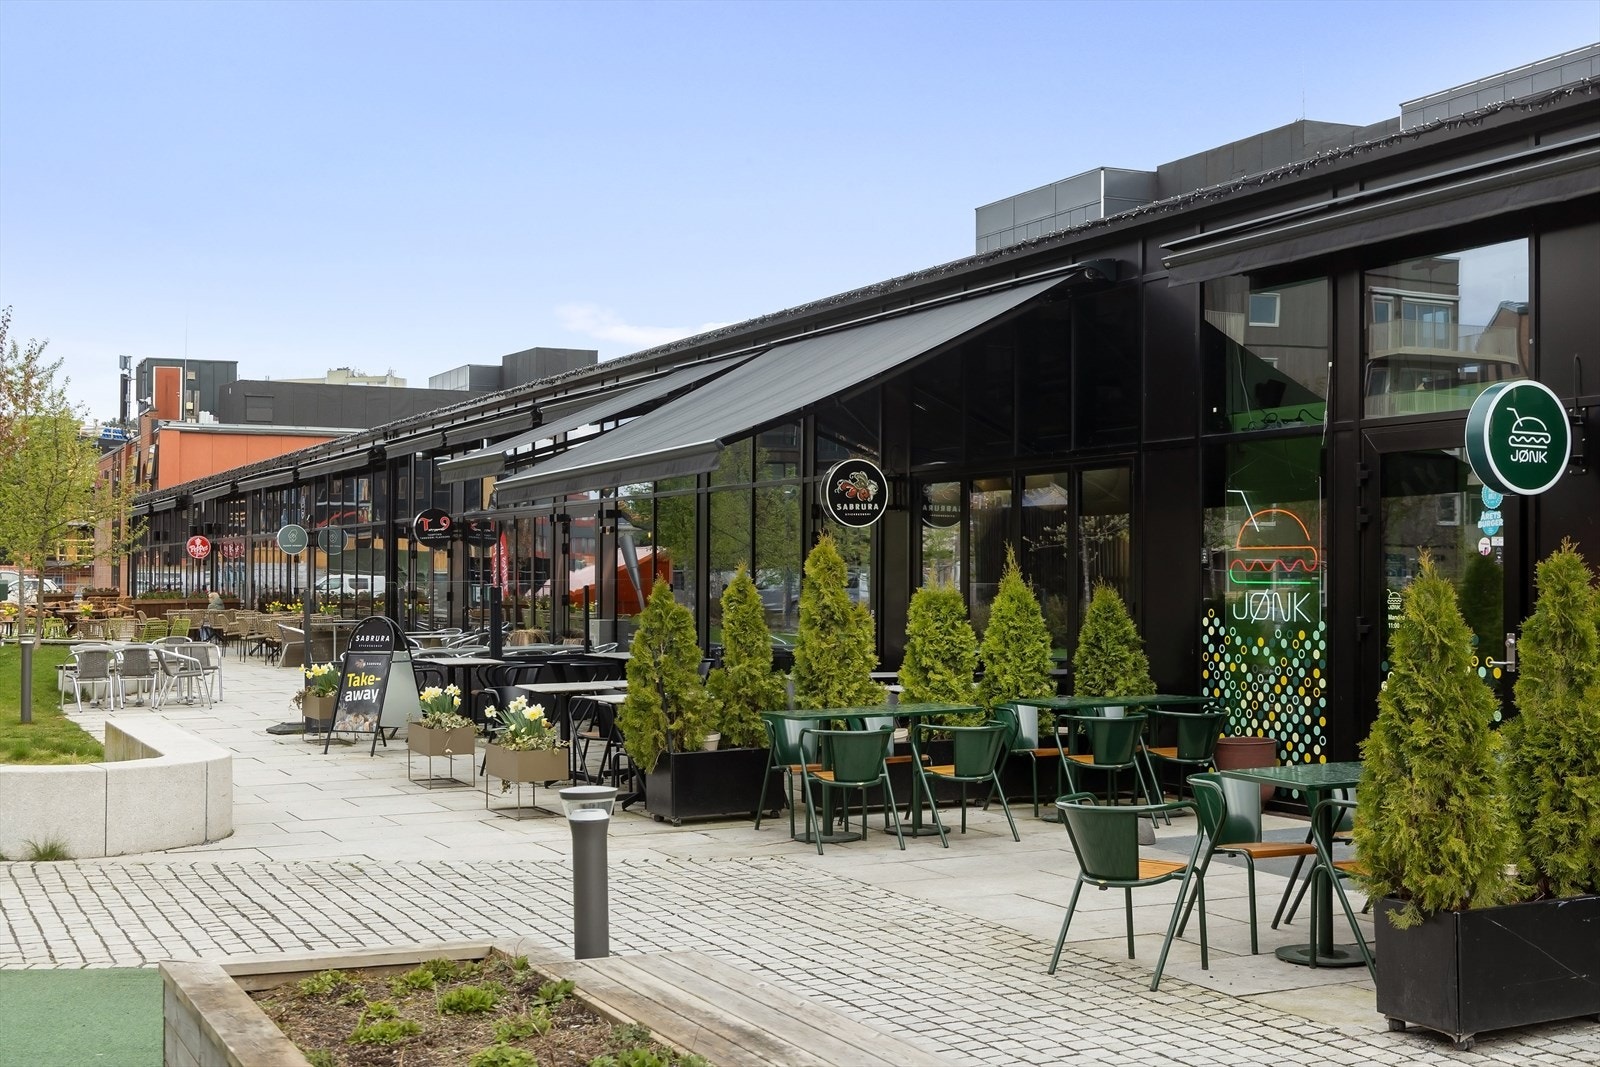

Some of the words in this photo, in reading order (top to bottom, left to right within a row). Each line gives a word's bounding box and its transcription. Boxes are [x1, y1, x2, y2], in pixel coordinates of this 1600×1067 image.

[1510, 449, 1548, 463] JØNK
[836, 503, 879, 511] SABRURA
[1478, 518, 1504, 529] BURGER
[1232, 589, 1311, 624] JØNK
[347, 672, 381, 687] Take-
[344, 688, 379, 703] away
